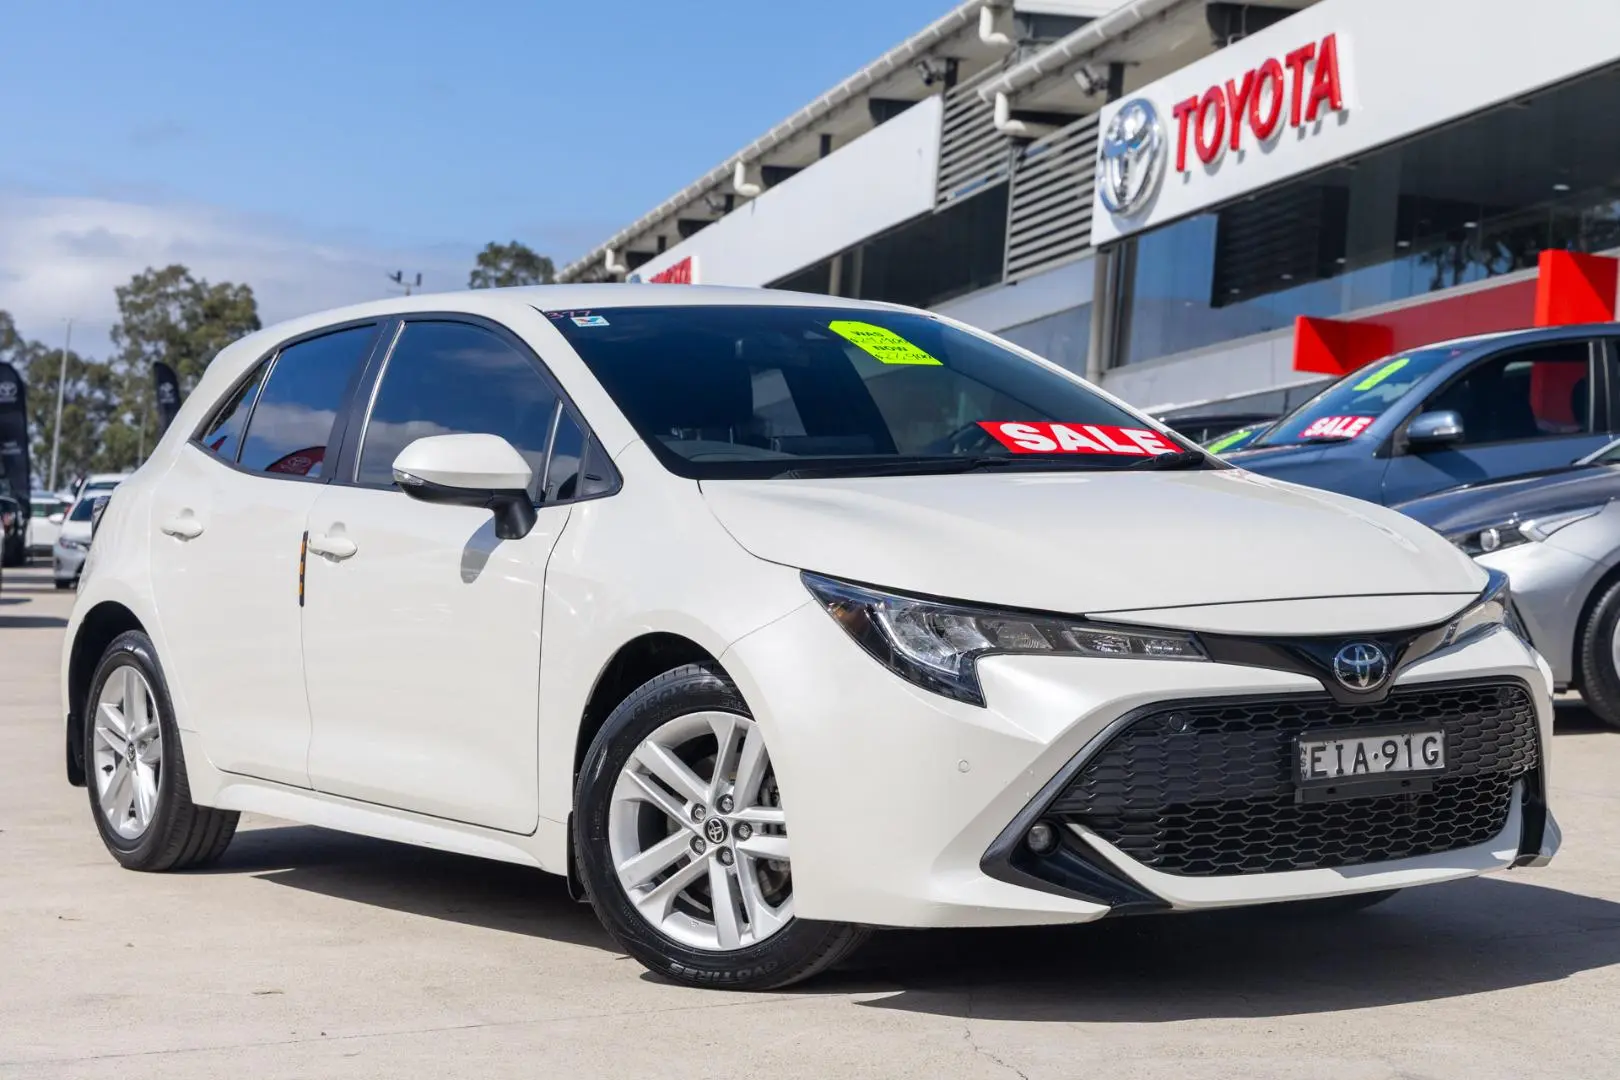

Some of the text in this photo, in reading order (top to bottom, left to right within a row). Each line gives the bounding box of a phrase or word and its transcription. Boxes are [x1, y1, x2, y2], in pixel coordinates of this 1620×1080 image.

[1173, 33, 1342, 172] TOYOTA
[1000, 423, 1176, 455] SALE
[1303, 416, 1371, 438] SALE
